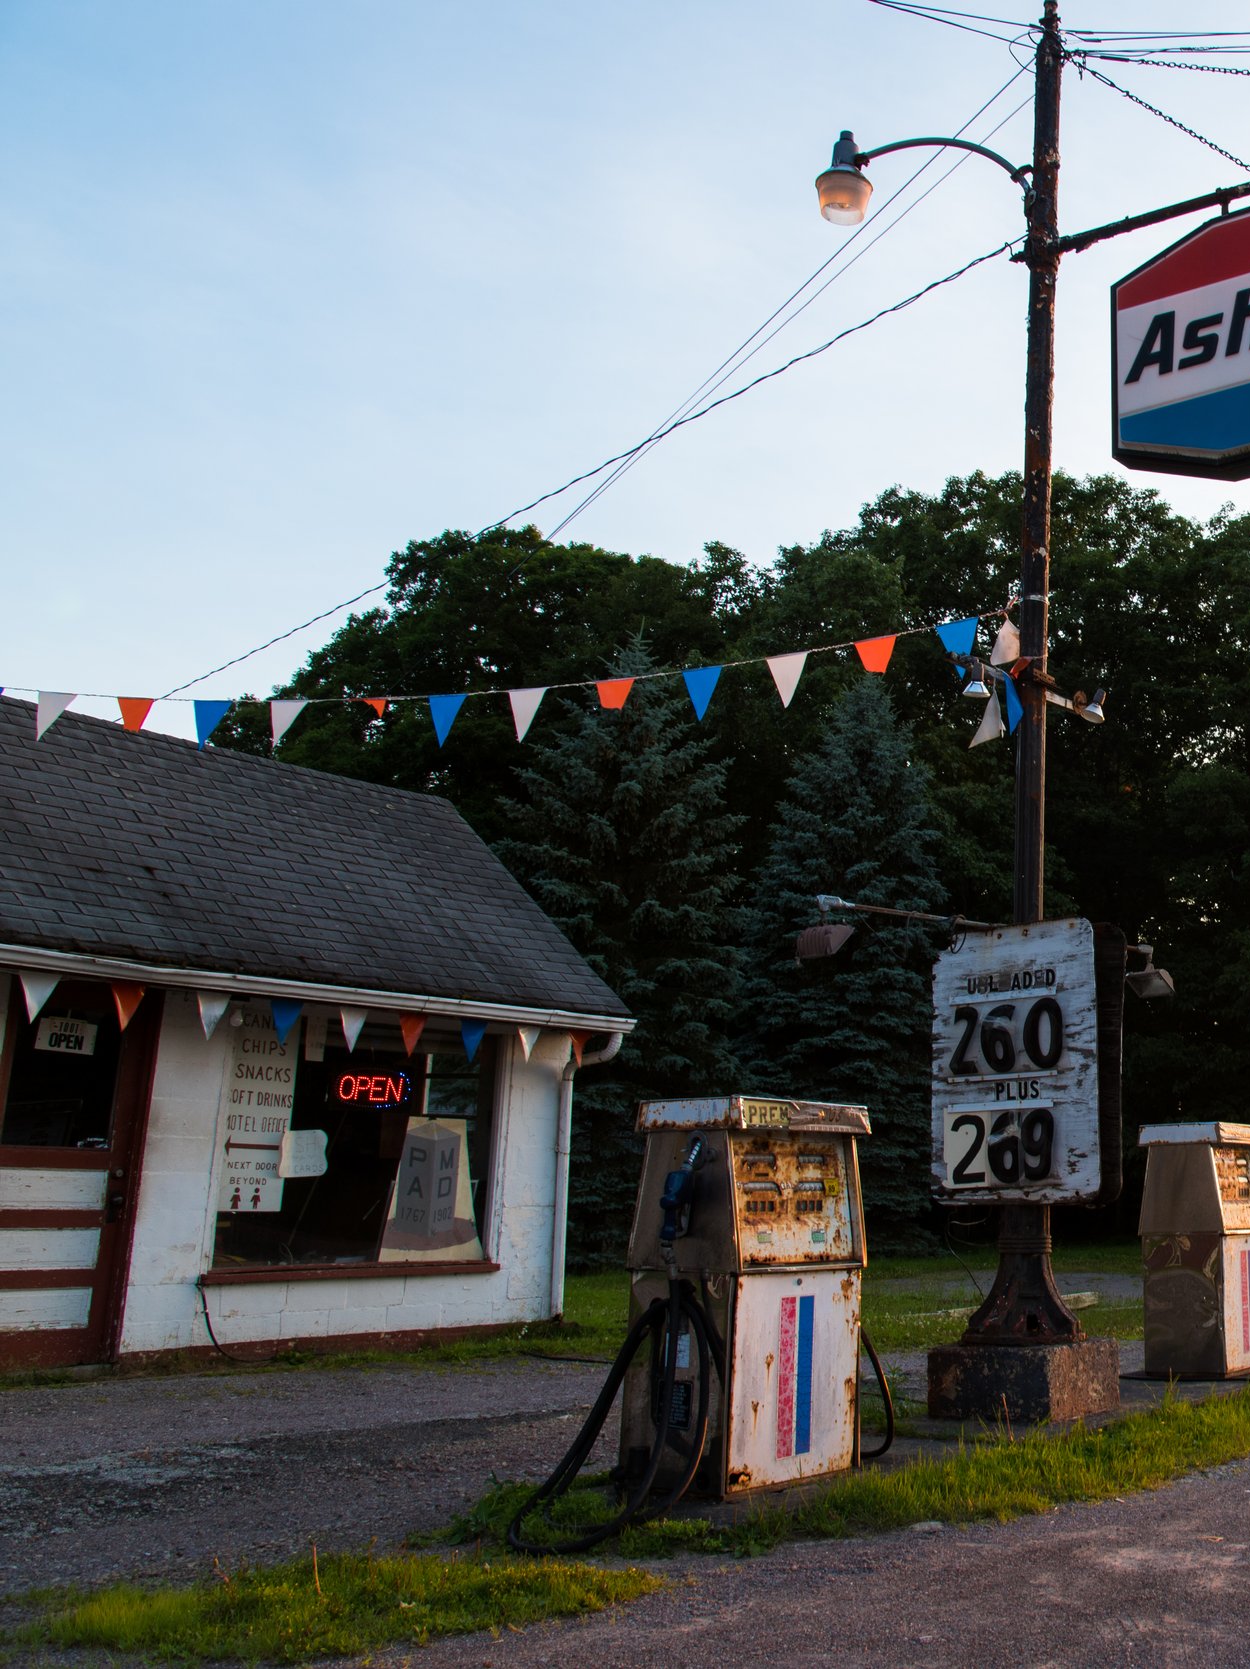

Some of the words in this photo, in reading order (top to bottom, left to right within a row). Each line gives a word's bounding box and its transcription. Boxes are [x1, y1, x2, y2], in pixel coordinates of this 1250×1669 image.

[967, 968, 1056, 995] ULADED
[243, 1013, 275, 1031] CAN
[48, 1032, 84, 1050] OPEN
[950, 997, 1063, 1075] 260
[242, 1038, 288, 1057] CHIPS
[235, 1063, 291, 1084] SNACKS
[338, 1074, 403, 1102] OPEN
[995, 1079, 1041, 1101] PLUS
[229, 1088, 253, 1106] OFT
[257, 1091, 293, 1109] DRINKS
[748, 1105, 789, 1124] PREM
[261, 1116, 289, 1134] OFFICE
[950, 1108, 1055, 1185] 269
[227, 1161, 252, 1170] NEXT
[255, 1162, 277, 1171] DOOR
[229, 1176, 267, 1186] BEYOND
[401, 1206, 426, 1223] 1767
